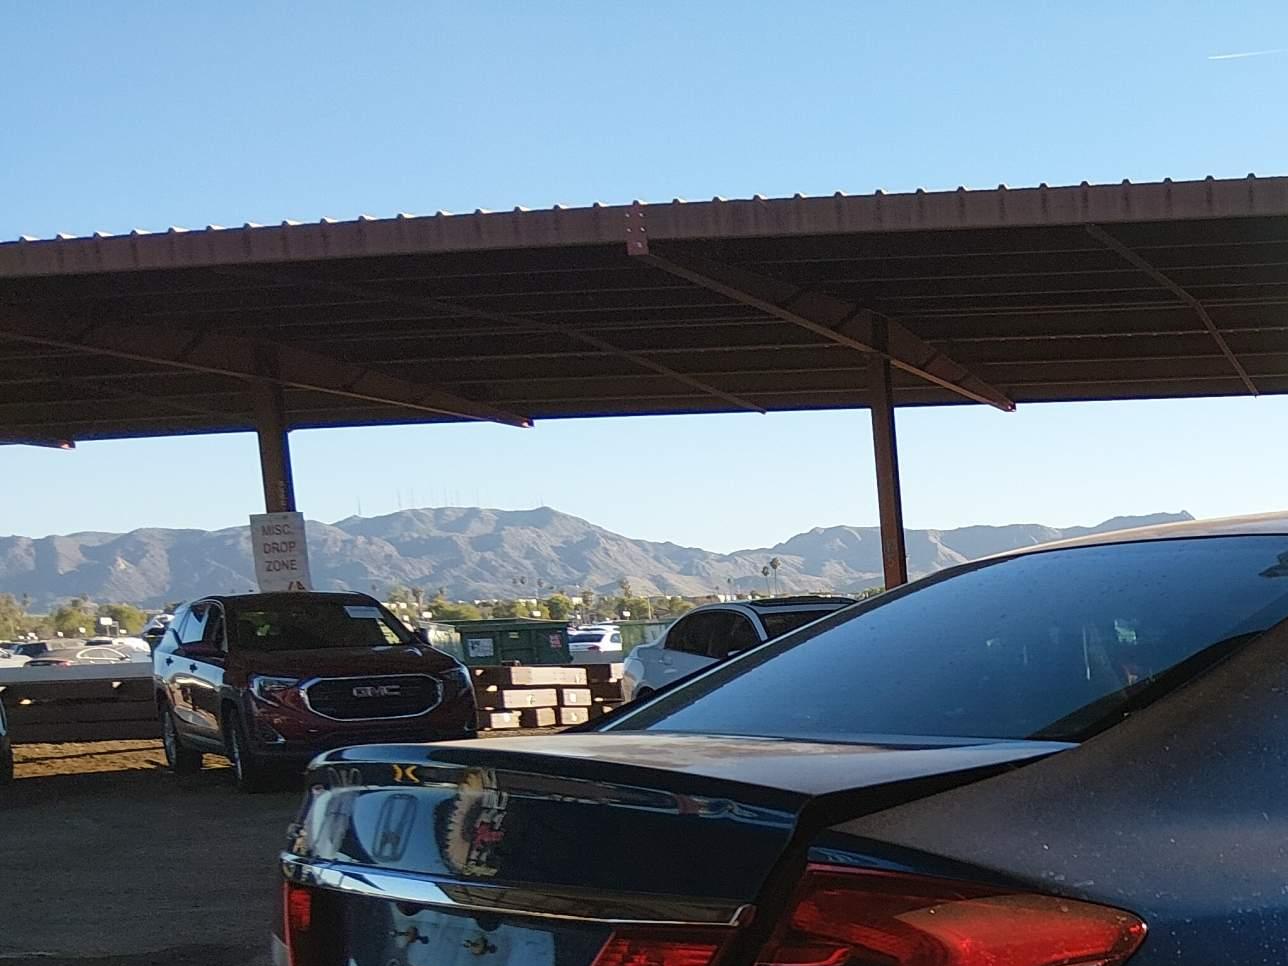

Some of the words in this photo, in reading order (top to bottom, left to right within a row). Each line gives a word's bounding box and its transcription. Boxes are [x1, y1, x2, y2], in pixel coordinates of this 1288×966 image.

[263, 540, 297, 554] DROP
[264, 559, 298, 572] ZONE
[352, 684, 401, 697] GMC
